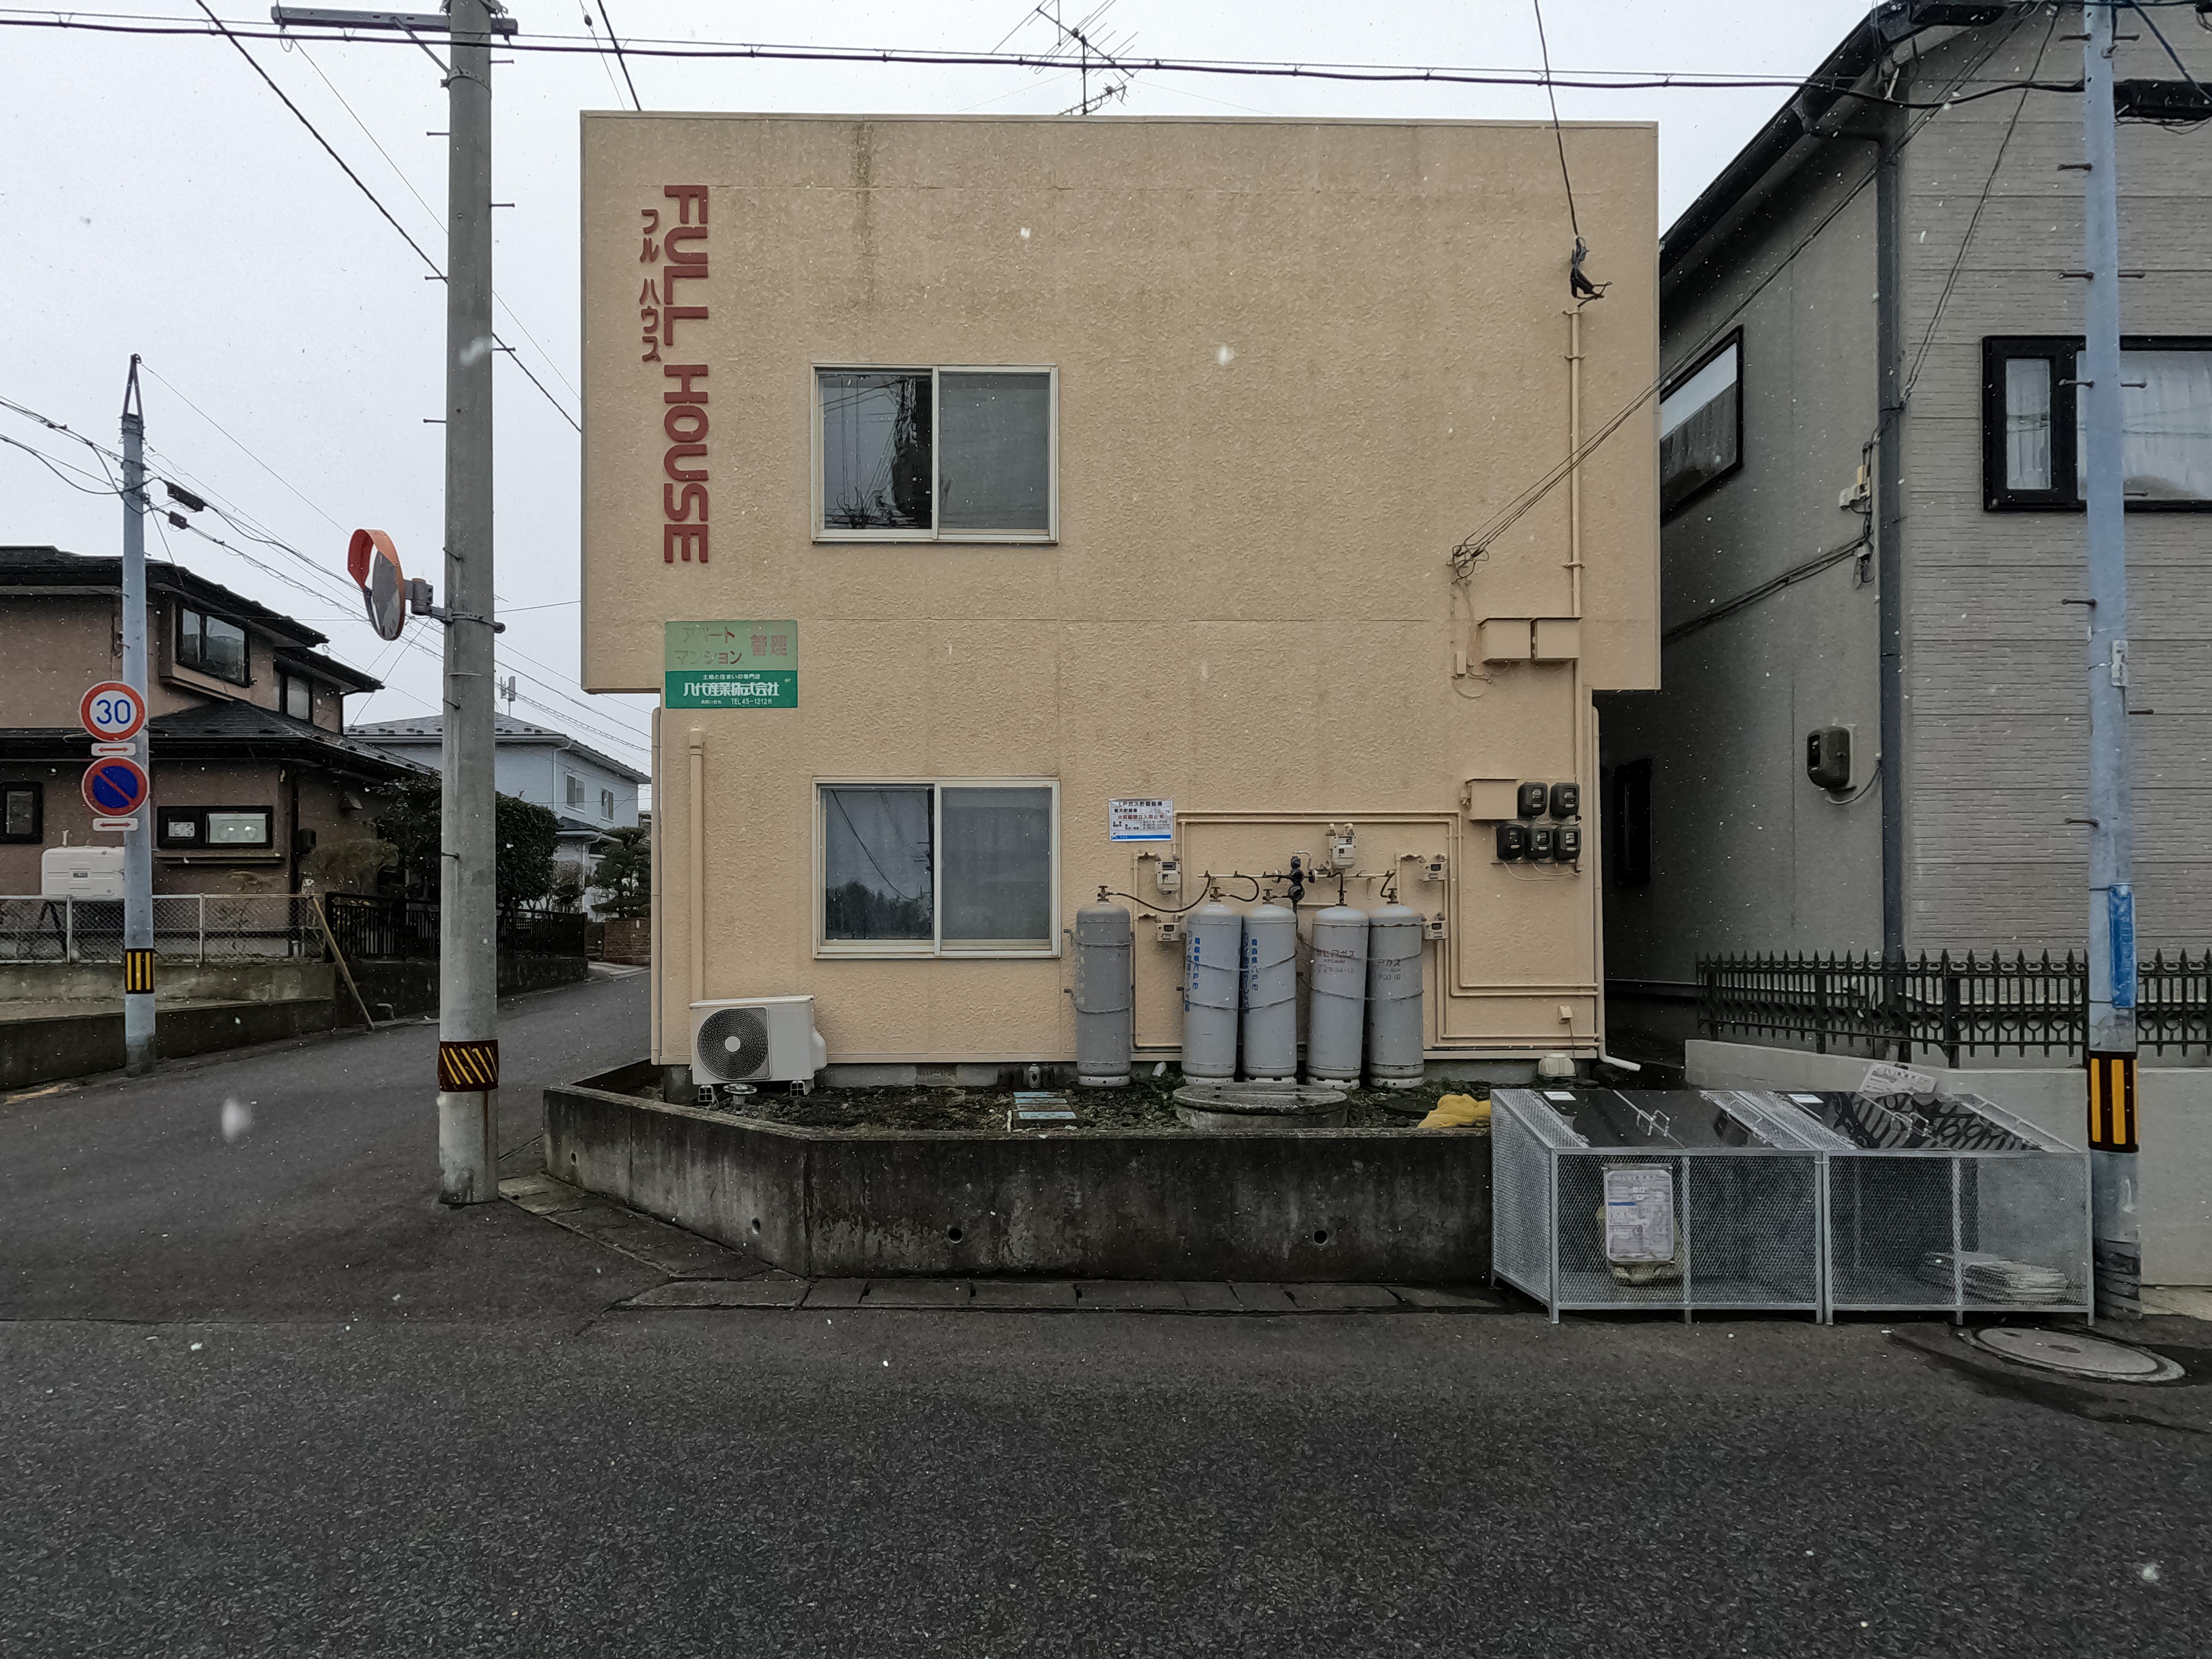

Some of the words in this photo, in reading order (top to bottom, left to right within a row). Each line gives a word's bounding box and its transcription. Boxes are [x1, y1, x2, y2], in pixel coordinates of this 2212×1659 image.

[639, 209, 660, 263] フル
[664, 185, 708, 346] FULL
[639, 277, 661, 361] ハウス
[664, 364, 709, 563] HOUSE
[96, 699, 131, 724] 30
